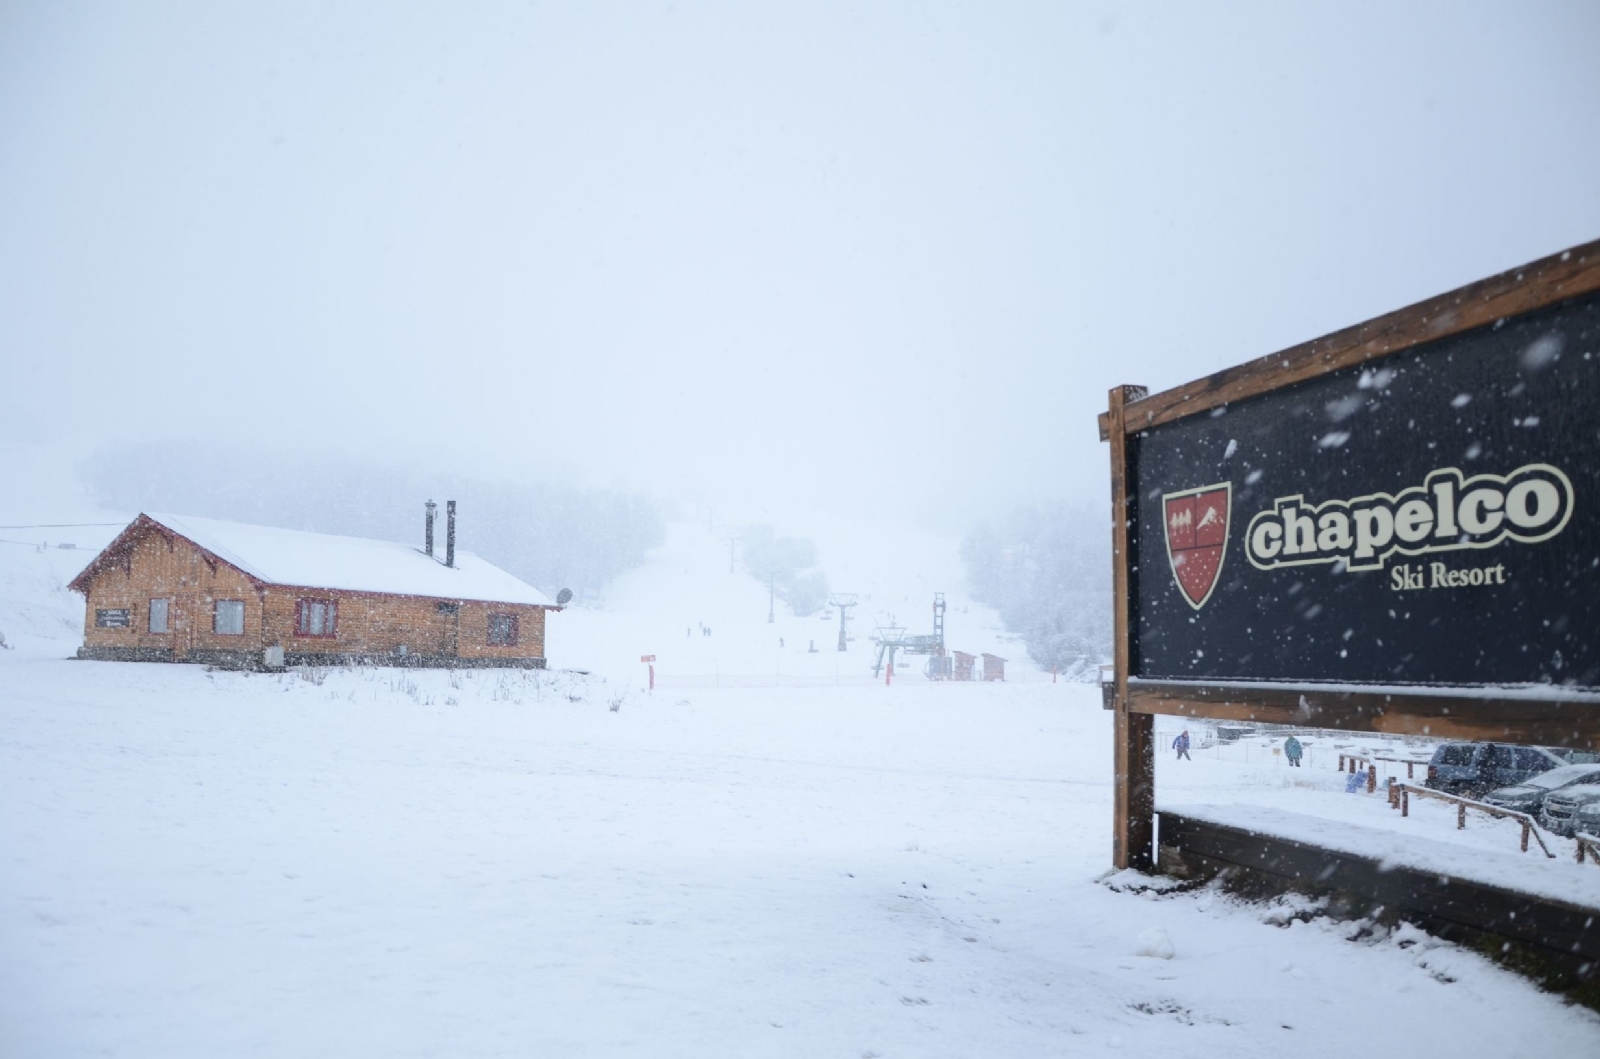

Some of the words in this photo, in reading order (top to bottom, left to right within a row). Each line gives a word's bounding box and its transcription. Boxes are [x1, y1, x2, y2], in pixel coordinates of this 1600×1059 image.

[1251, 479, 1560, 558] chapelco
[1391, 563, 1425, 591] Ski
[1430, 561, 1506, 588] Resort
